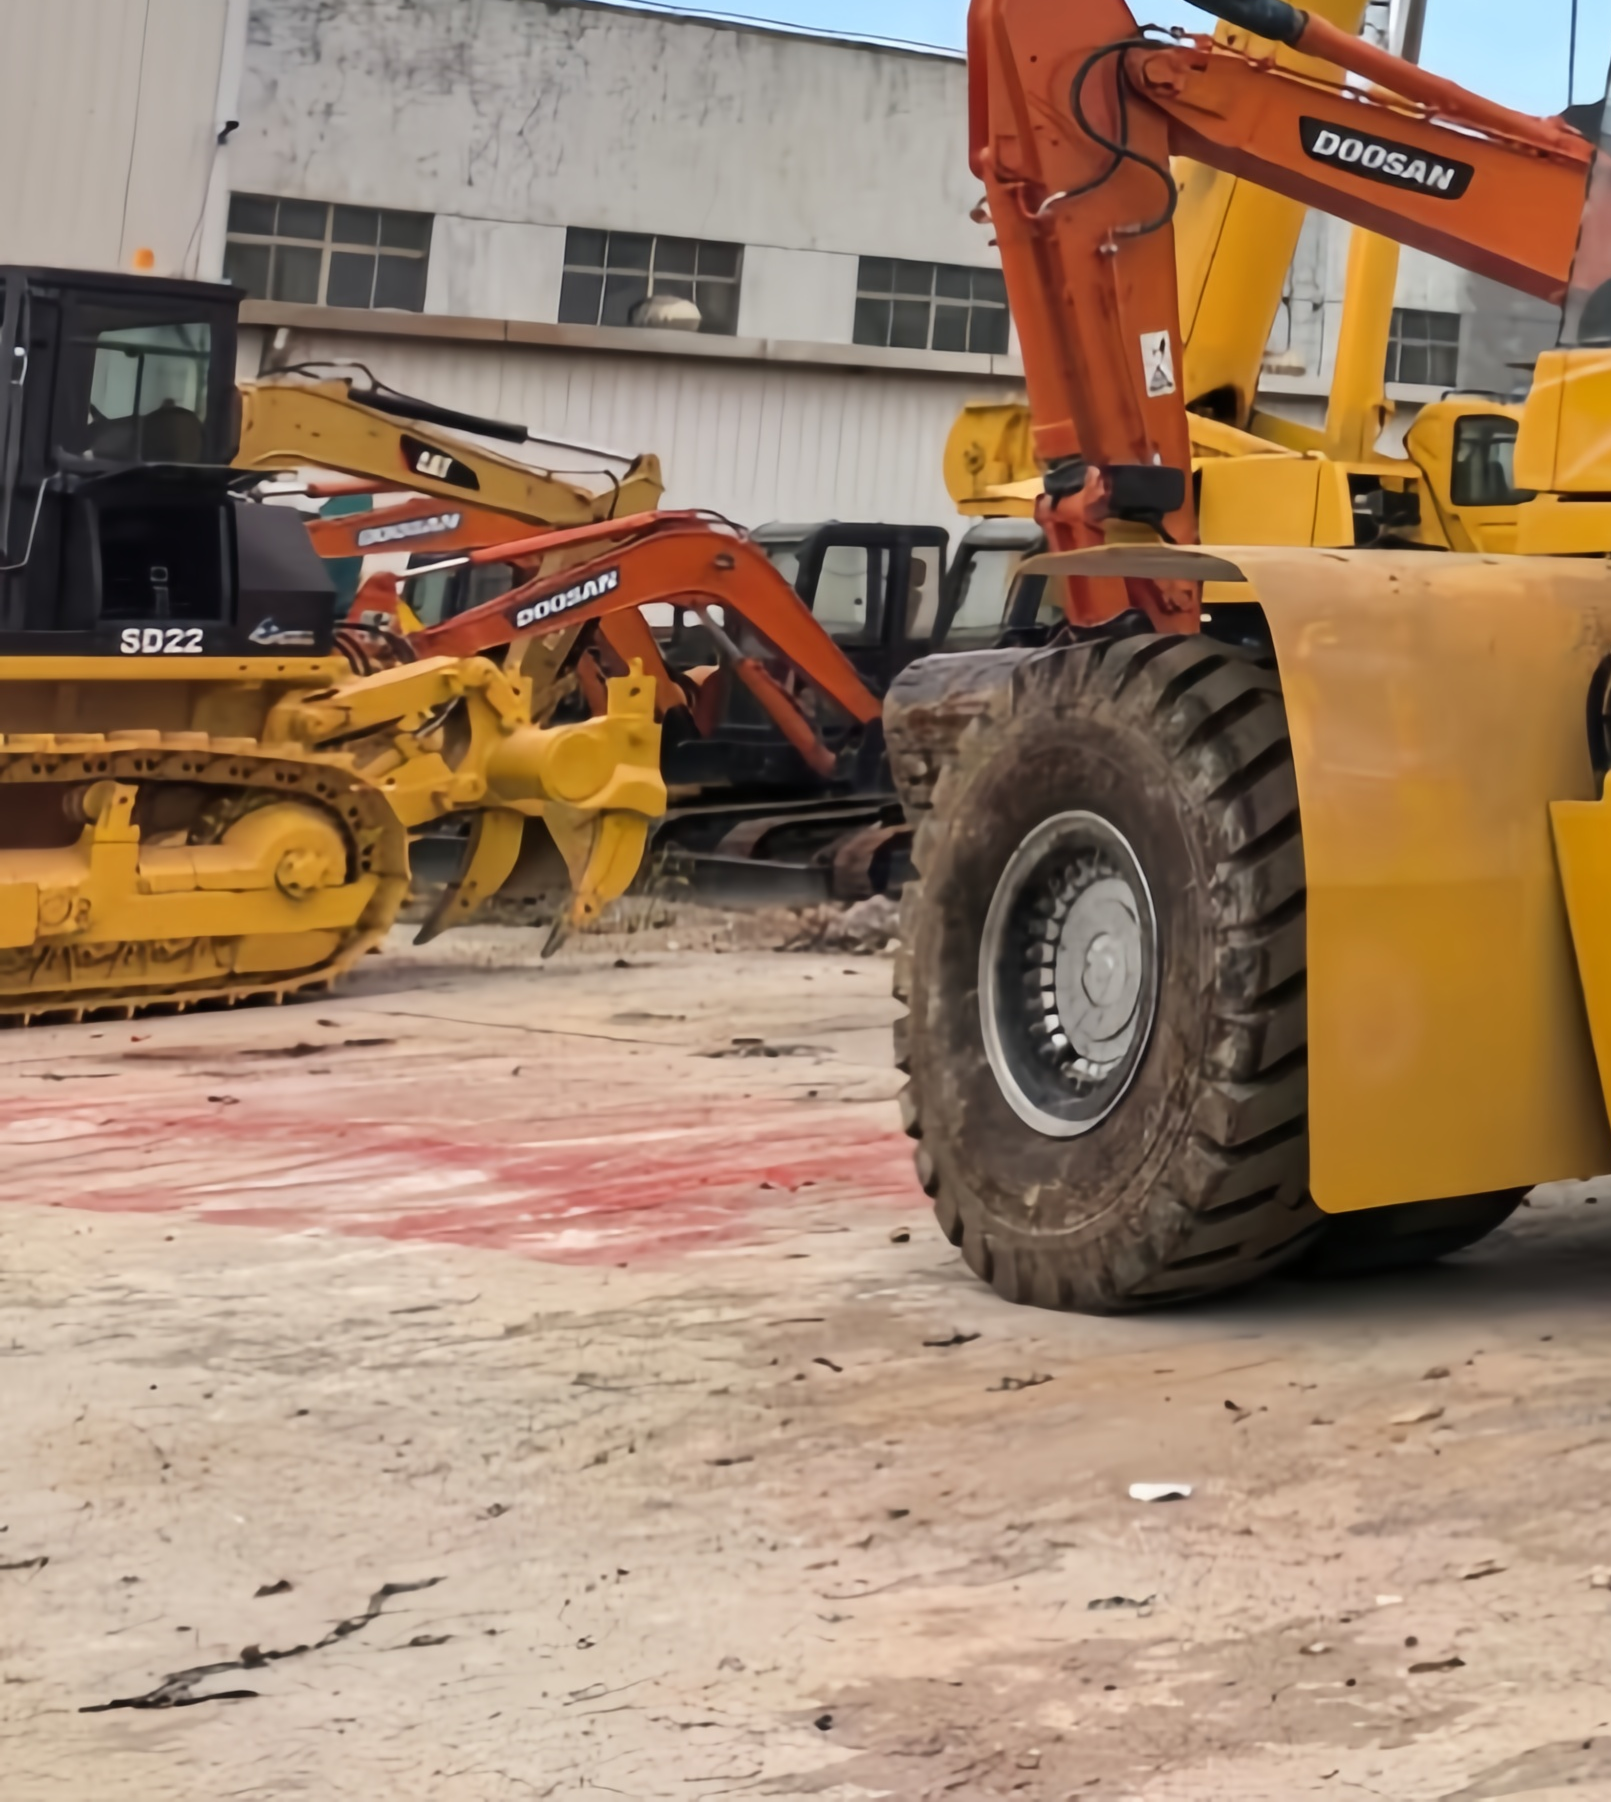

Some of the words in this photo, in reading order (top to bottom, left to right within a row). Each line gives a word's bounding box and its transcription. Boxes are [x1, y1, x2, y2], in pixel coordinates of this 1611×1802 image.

[1312, 129, 1456, 190] DOOSAN
[516, 569, 618, 628] DOOSAN
[120, 627, 204, 654] SD22
